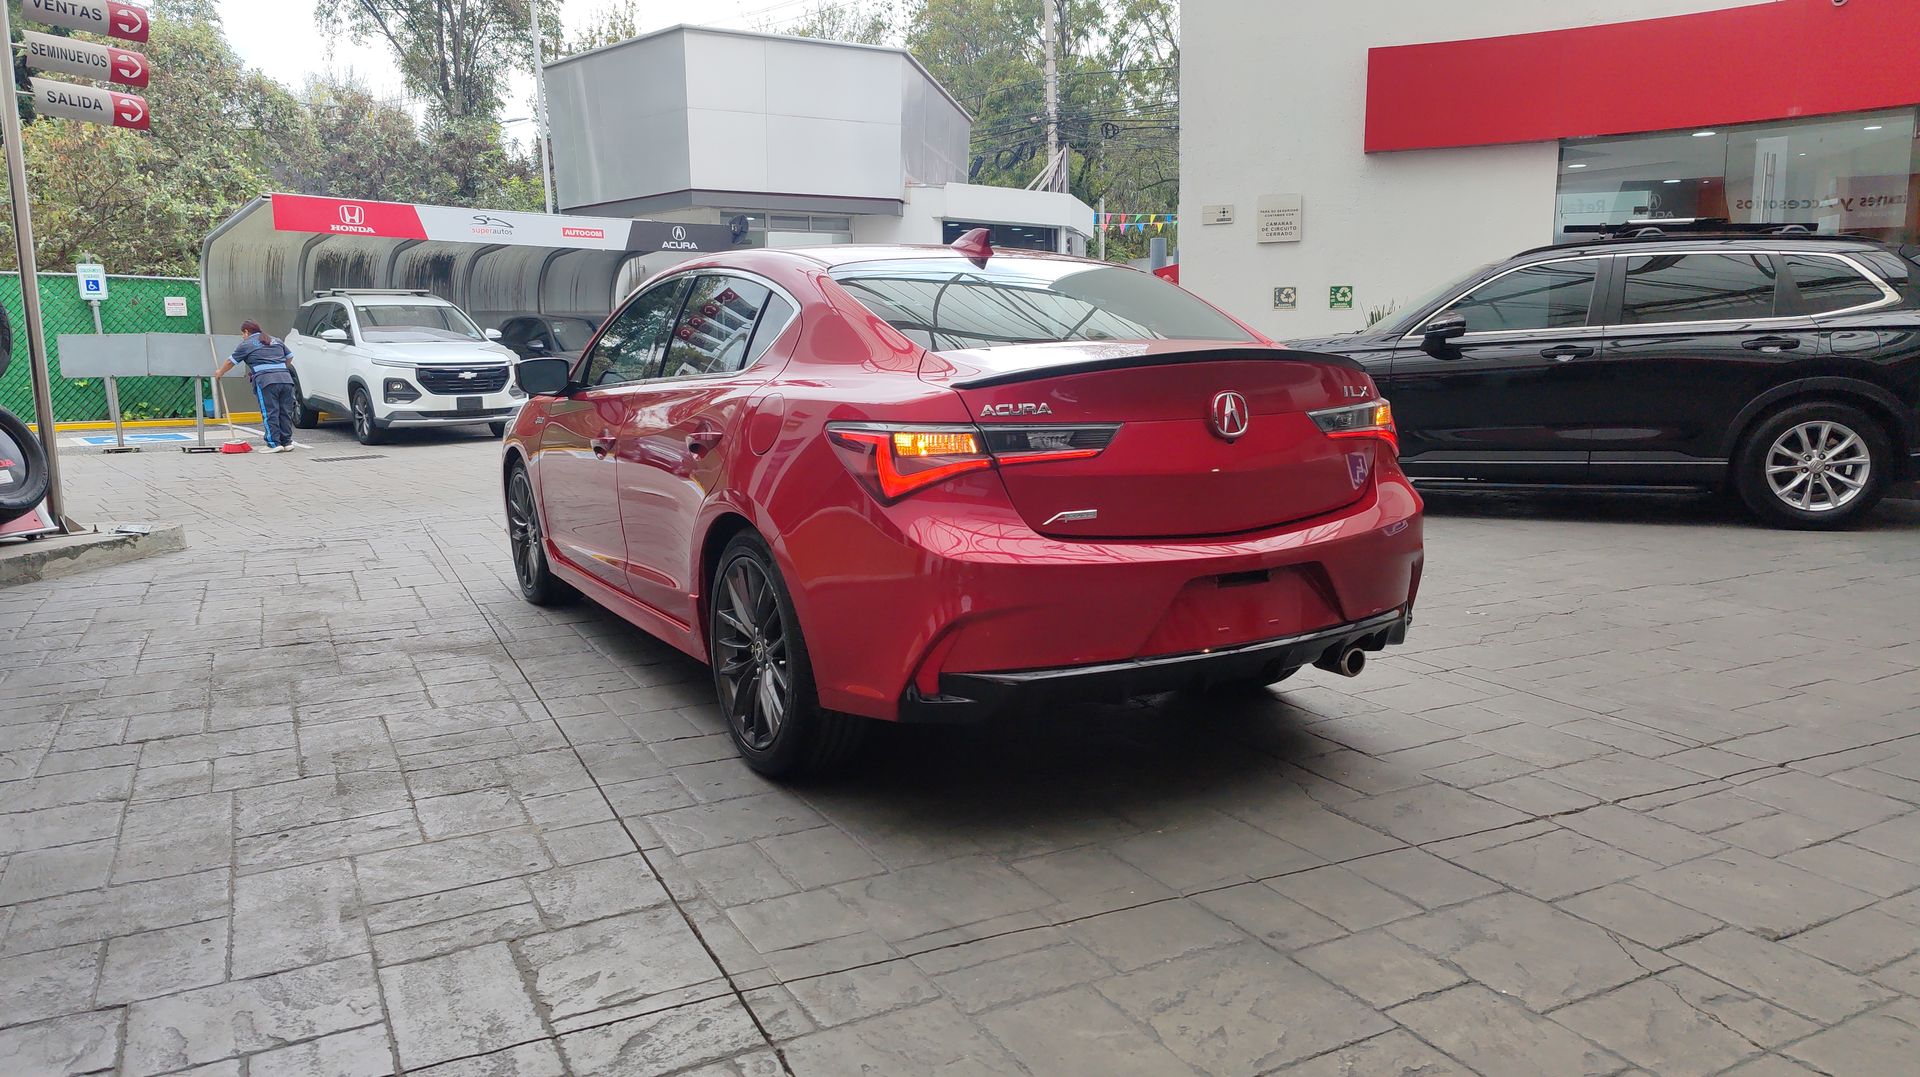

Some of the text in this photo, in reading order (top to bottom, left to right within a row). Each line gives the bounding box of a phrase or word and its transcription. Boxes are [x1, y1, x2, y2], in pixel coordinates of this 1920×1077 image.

[33, 0, 103, 21] VENTAS
[31, 42, 108, 68] SEMINUEVOS
[47, 90, 103, 111] SALIDA
[330, 224, 376, 234] HONDA
[471, 227, 513, 236] superautos
[564, 229, 603, 237] AUTOCOM
[661, 241, 699, 250] ACURA
[1343, 385, 1369, 398] ILX
[980, 403, 1053, 417] ACURA
